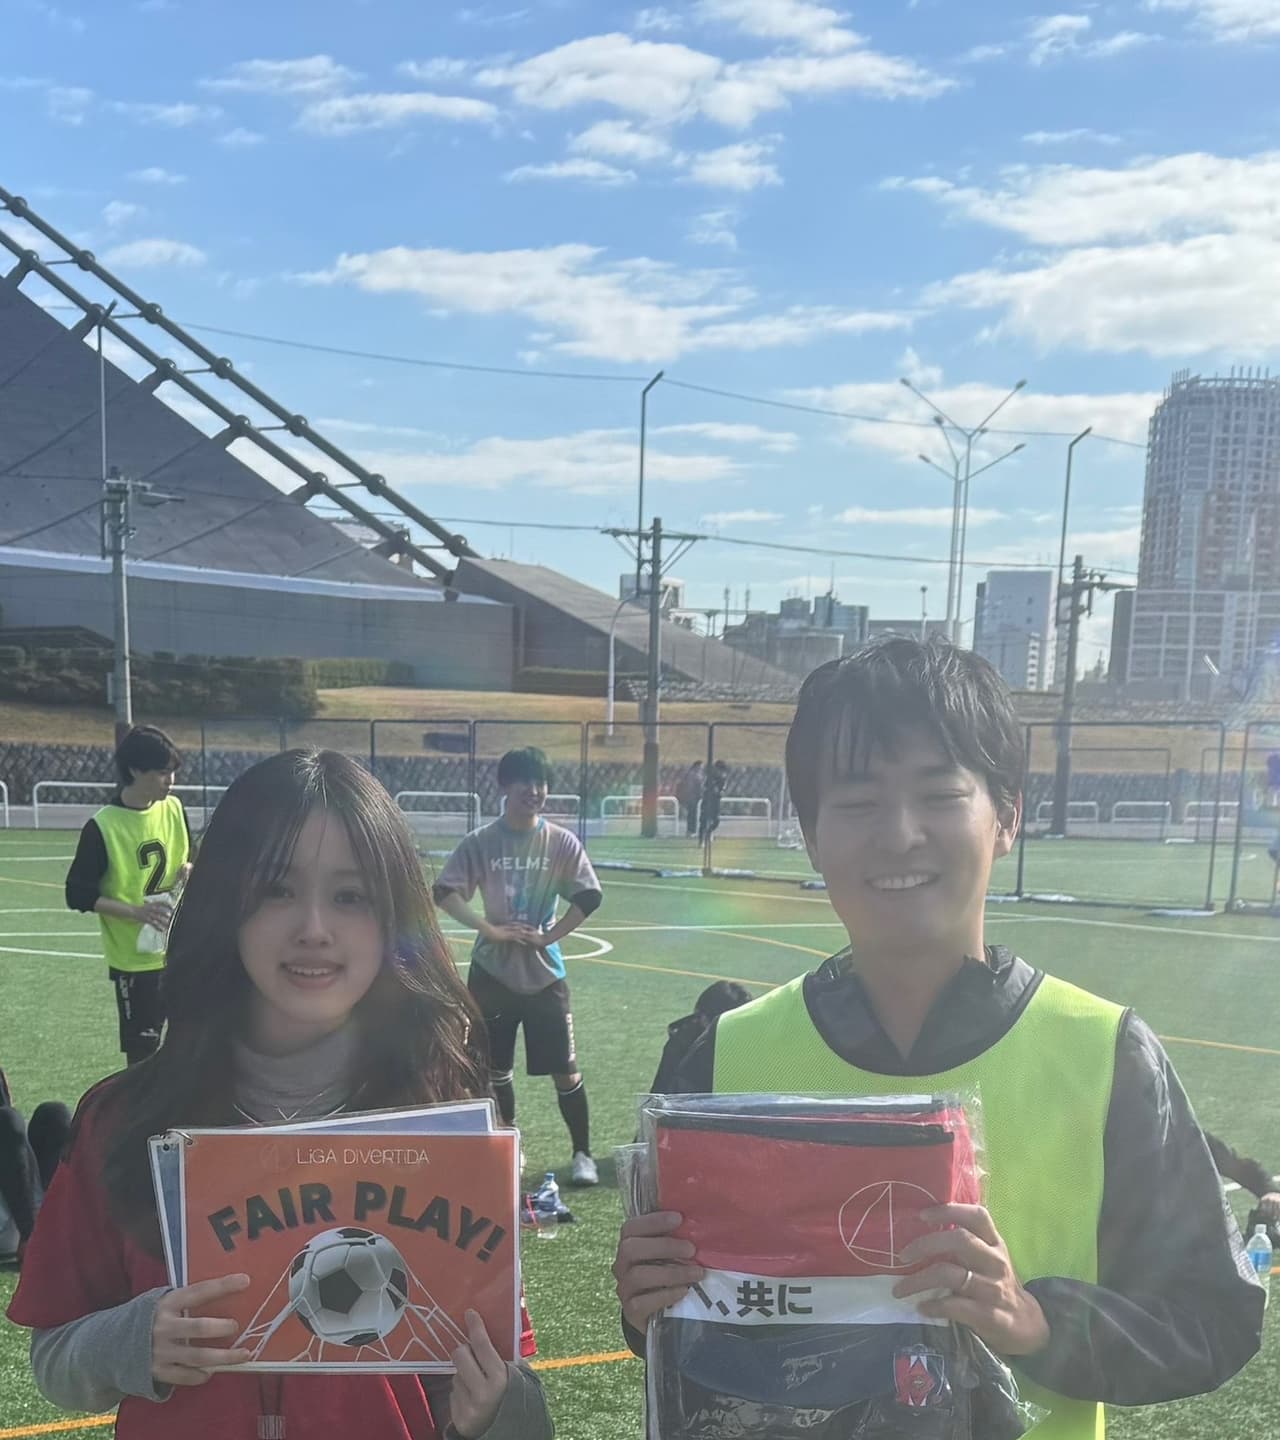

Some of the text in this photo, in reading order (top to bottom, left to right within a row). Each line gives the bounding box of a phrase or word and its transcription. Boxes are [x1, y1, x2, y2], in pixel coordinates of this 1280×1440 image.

[136, 839, 175, 896] 2
[490, 855, 551, 873] KELME
[208, 1181, 506, 1262] FAIR PLAY!
